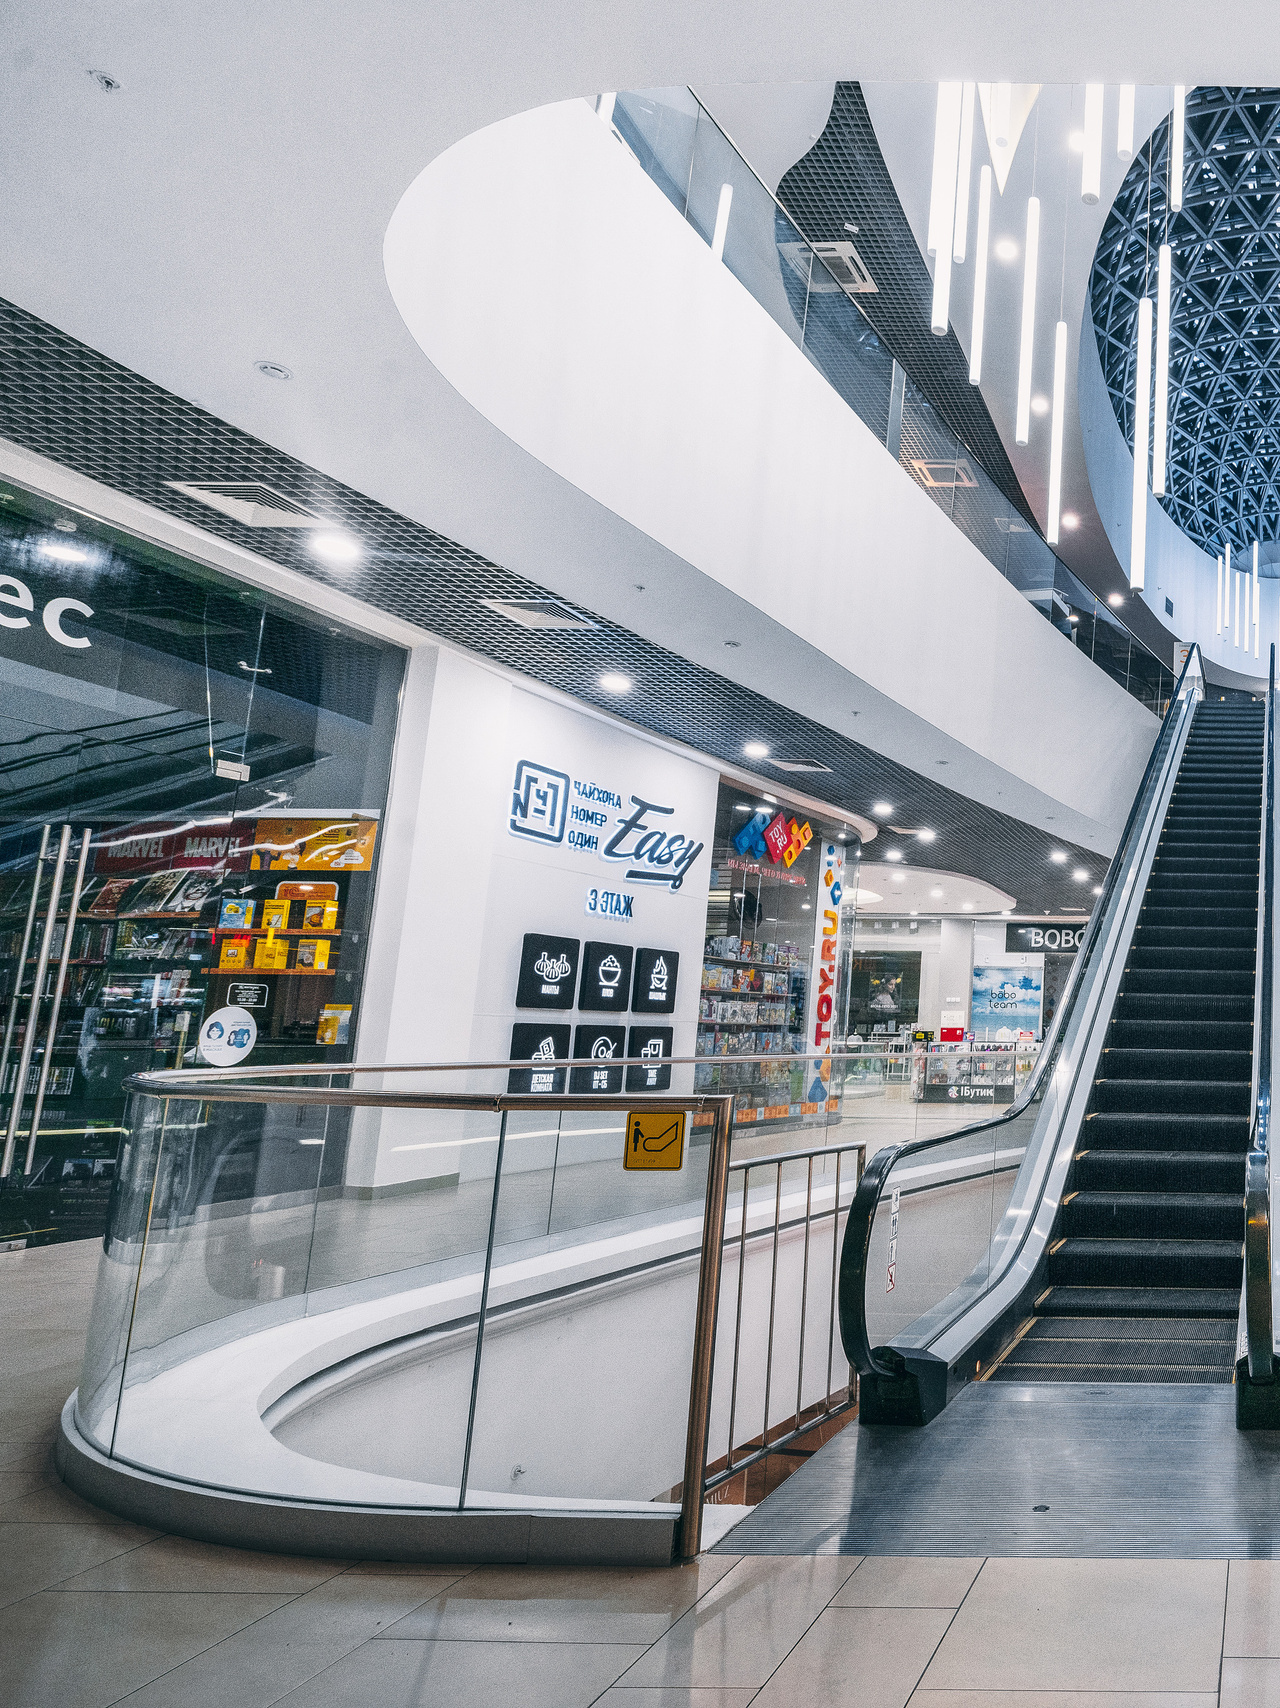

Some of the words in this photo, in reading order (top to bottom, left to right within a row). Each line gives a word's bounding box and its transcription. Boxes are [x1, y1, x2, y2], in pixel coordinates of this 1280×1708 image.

[573, 780, 622, 809] ЧАЙХОНА
[570, 804, 608, 827] НОМЕР
[568, 830, 599, 851] ОДИН
[603, 795, 705, 890] Easy
[769, 821, 783, 843] TOY
[184, 837, 240, 858] MARVEL
[588, 888, 598, 911] 3
[600, 891, 634, 918] ЭТАЖ
[815, 909, 838, 1046] TOY.RU
[988, 999, 1018, 1009] team
[530, 1082, 553, 1093] КОМНАТА
[532, 1073, 554, 1083] ДЕТСКАЯ
